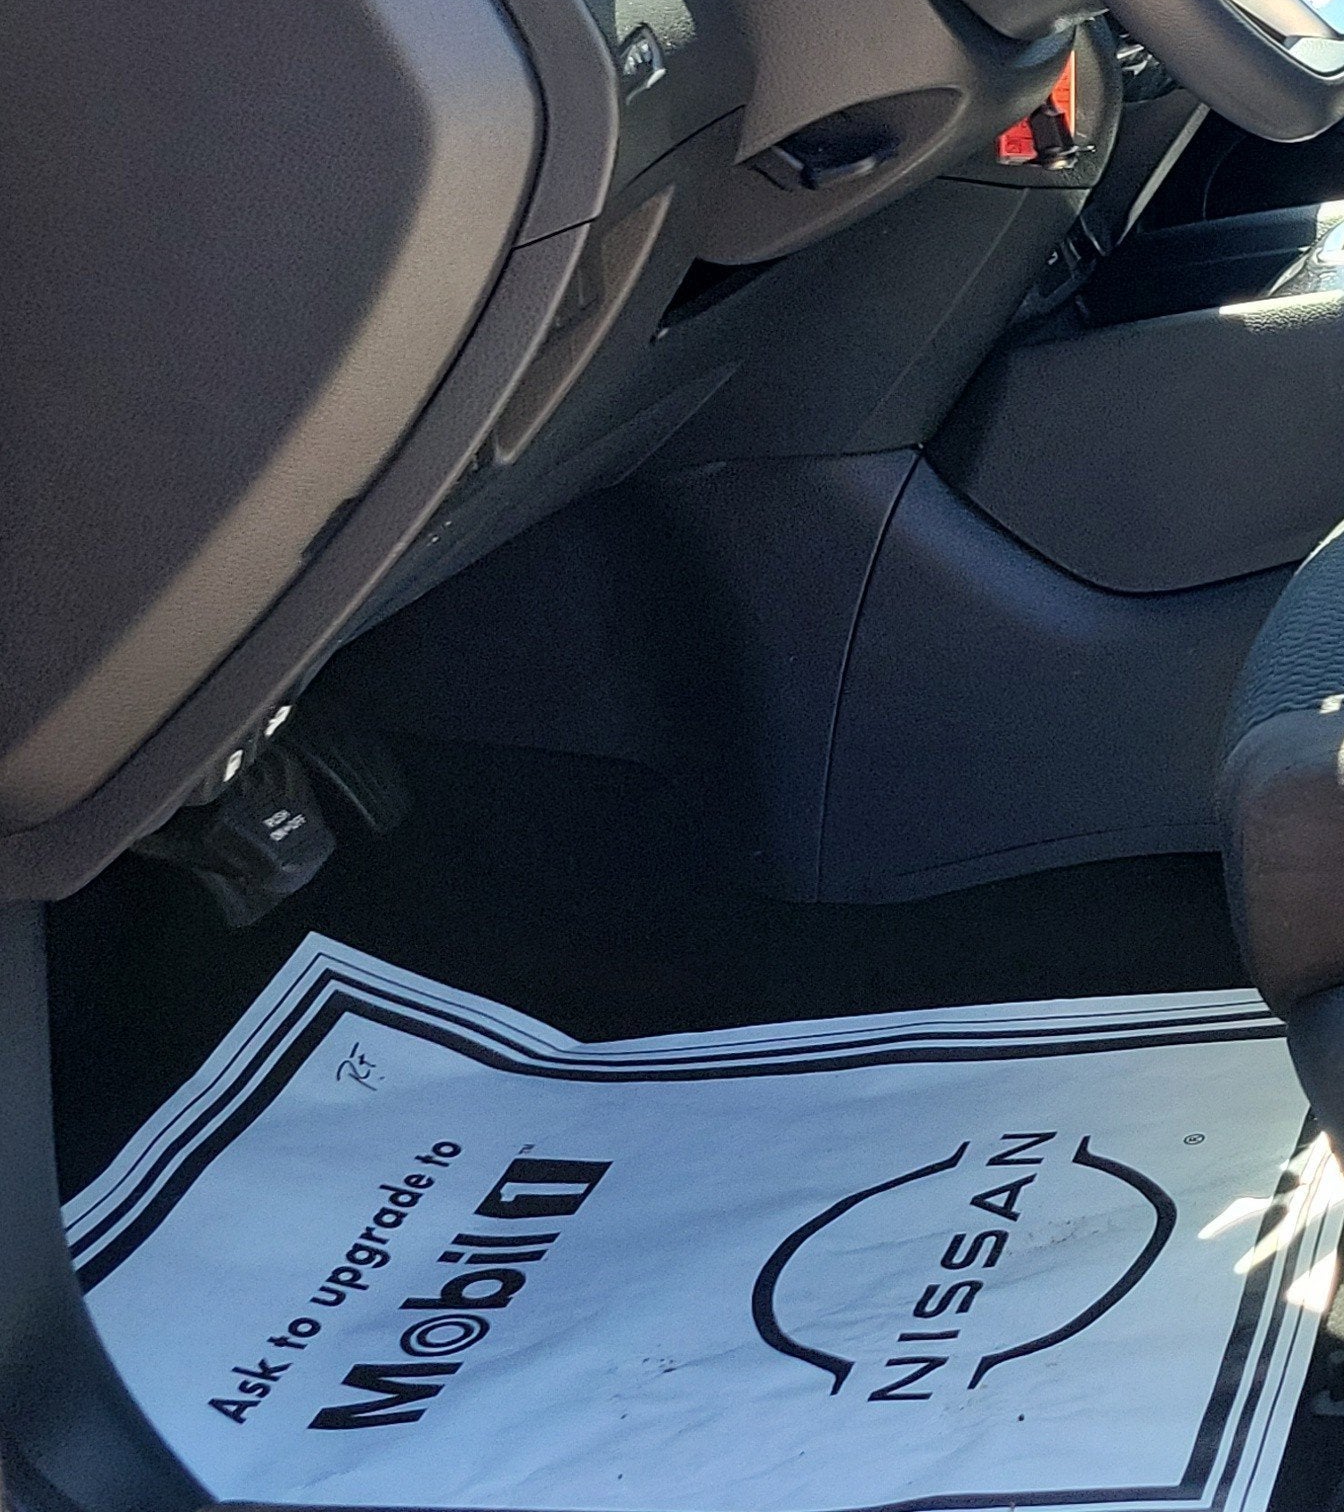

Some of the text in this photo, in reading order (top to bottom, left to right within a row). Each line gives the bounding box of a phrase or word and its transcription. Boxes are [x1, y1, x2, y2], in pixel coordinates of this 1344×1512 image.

[208, 1141, 462, 1424] Ask to upgrade to
[307, 1232, 561, 1430] Mobil
[867, 1131, 1058, 1403] NISSAN
